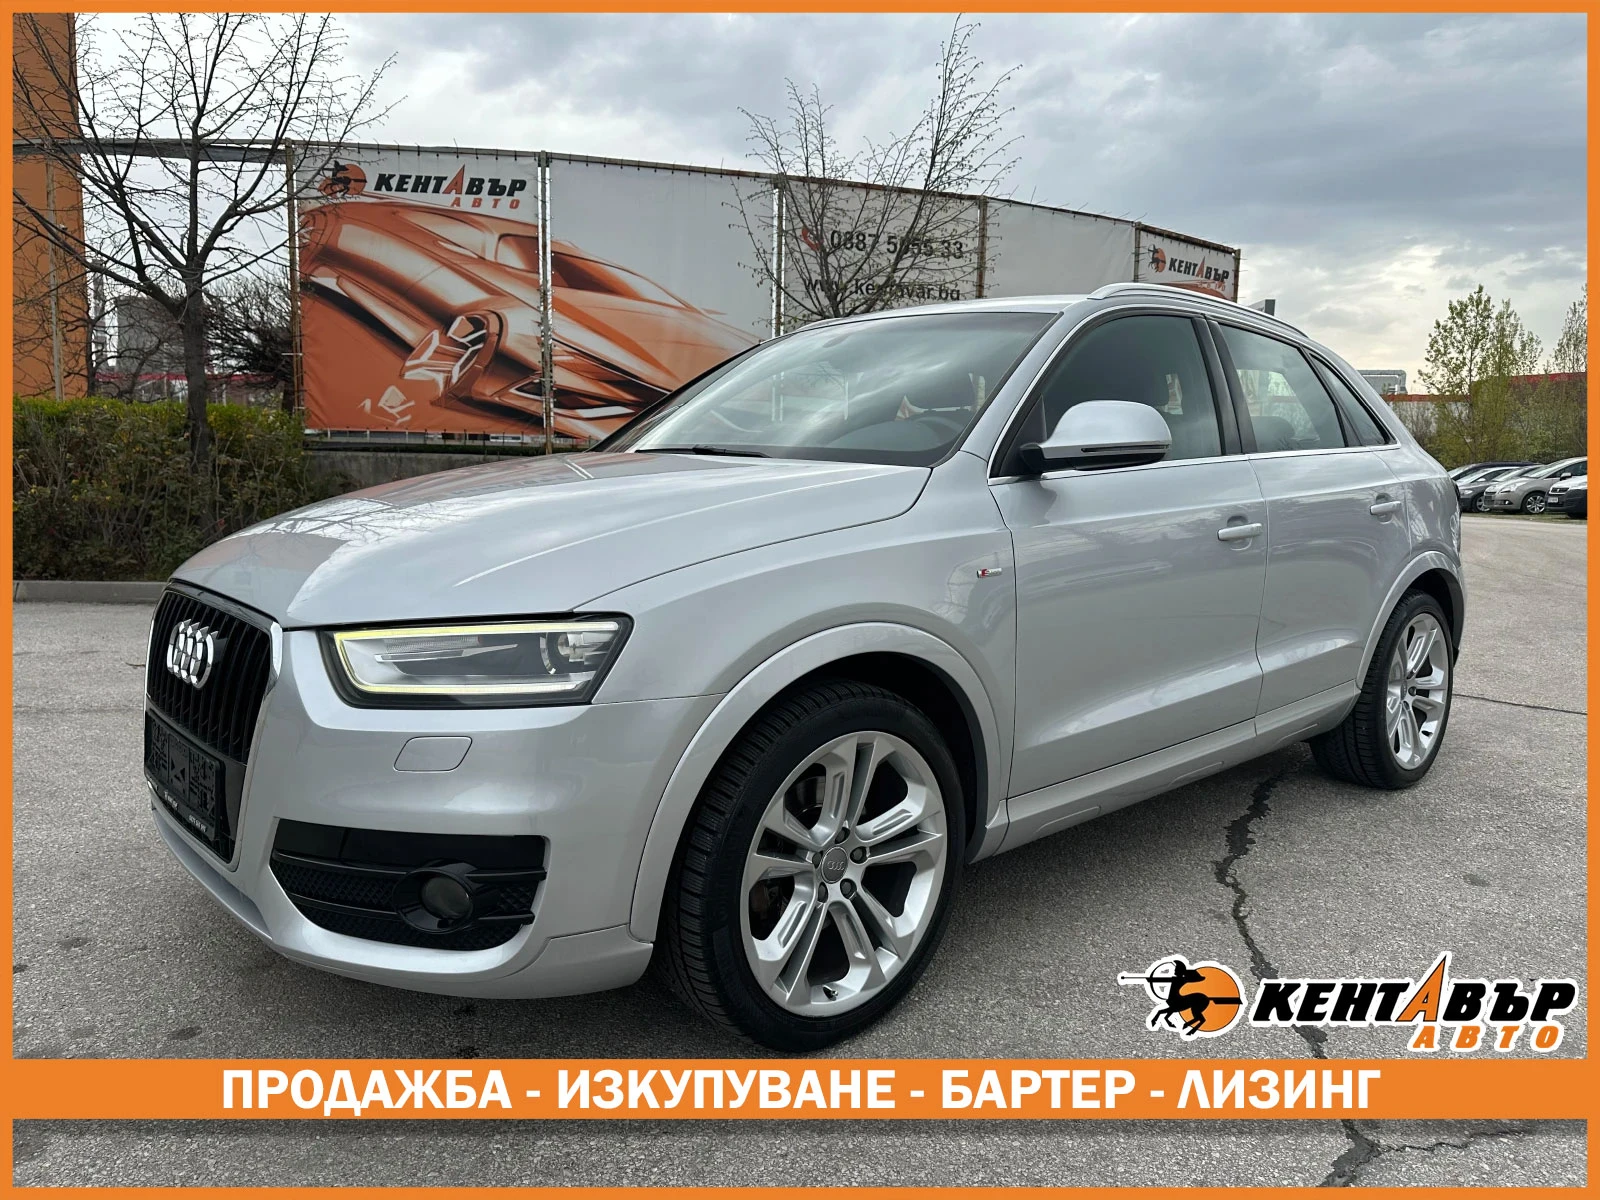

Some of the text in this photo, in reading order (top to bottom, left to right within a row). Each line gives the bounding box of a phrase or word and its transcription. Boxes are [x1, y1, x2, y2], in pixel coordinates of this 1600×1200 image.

[374, 164, 527, 197] КЕНТАВЪР
[450, 197, 521, 210] АВТО
[887, 235, 934, 256] 555
[1168, 256, 1230, 282] КЕНТАВЪР
